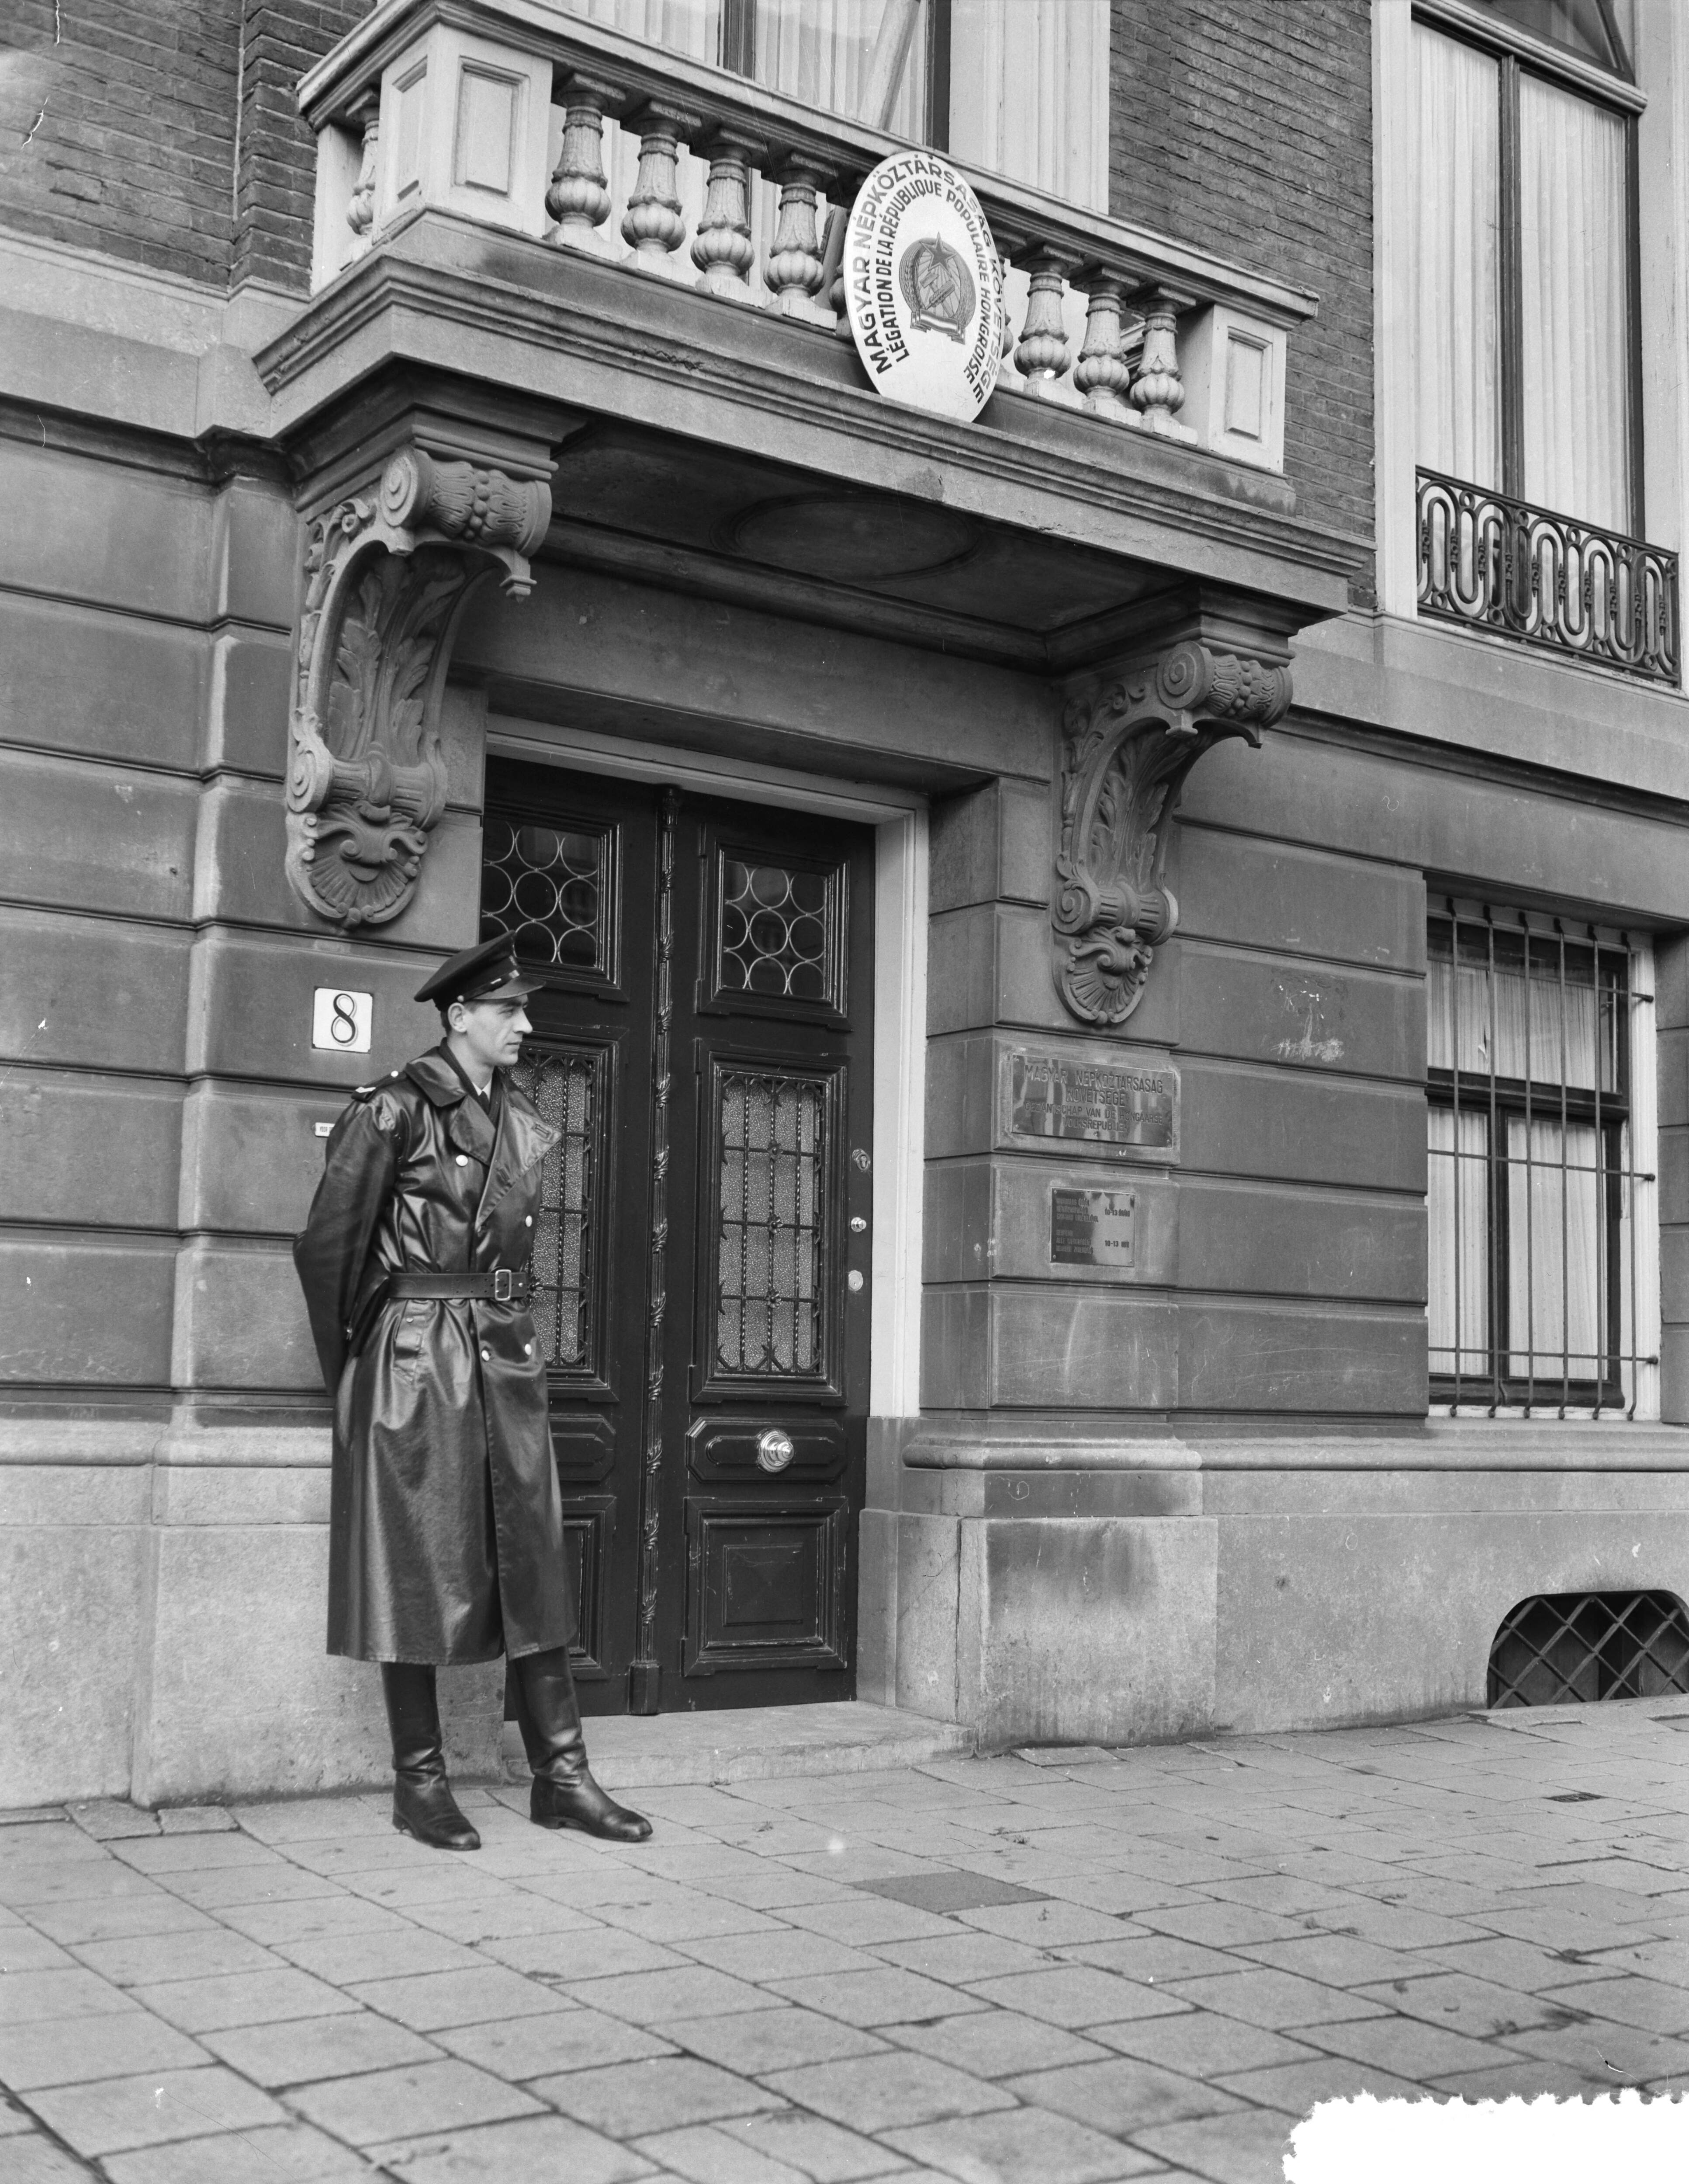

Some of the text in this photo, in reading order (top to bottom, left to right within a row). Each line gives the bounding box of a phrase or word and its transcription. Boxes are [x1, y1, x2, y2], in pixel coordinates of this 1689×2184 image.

[876, 179, 991, 380] LÉGATION DE LA RÉPUBLIQUE POPULAIRE HONGROISE
[852, 256, 892, 374] MAGYAR
[331, 993, 358, 1046] 8
[1024, 1064, 1068, 1084] MAGYAR
[1086, 1107, 1101, 1118] VAN
[1105, 1109, 1116, 1120] DE
[1119, 1111, 1163, 1125] HONGAARSE
